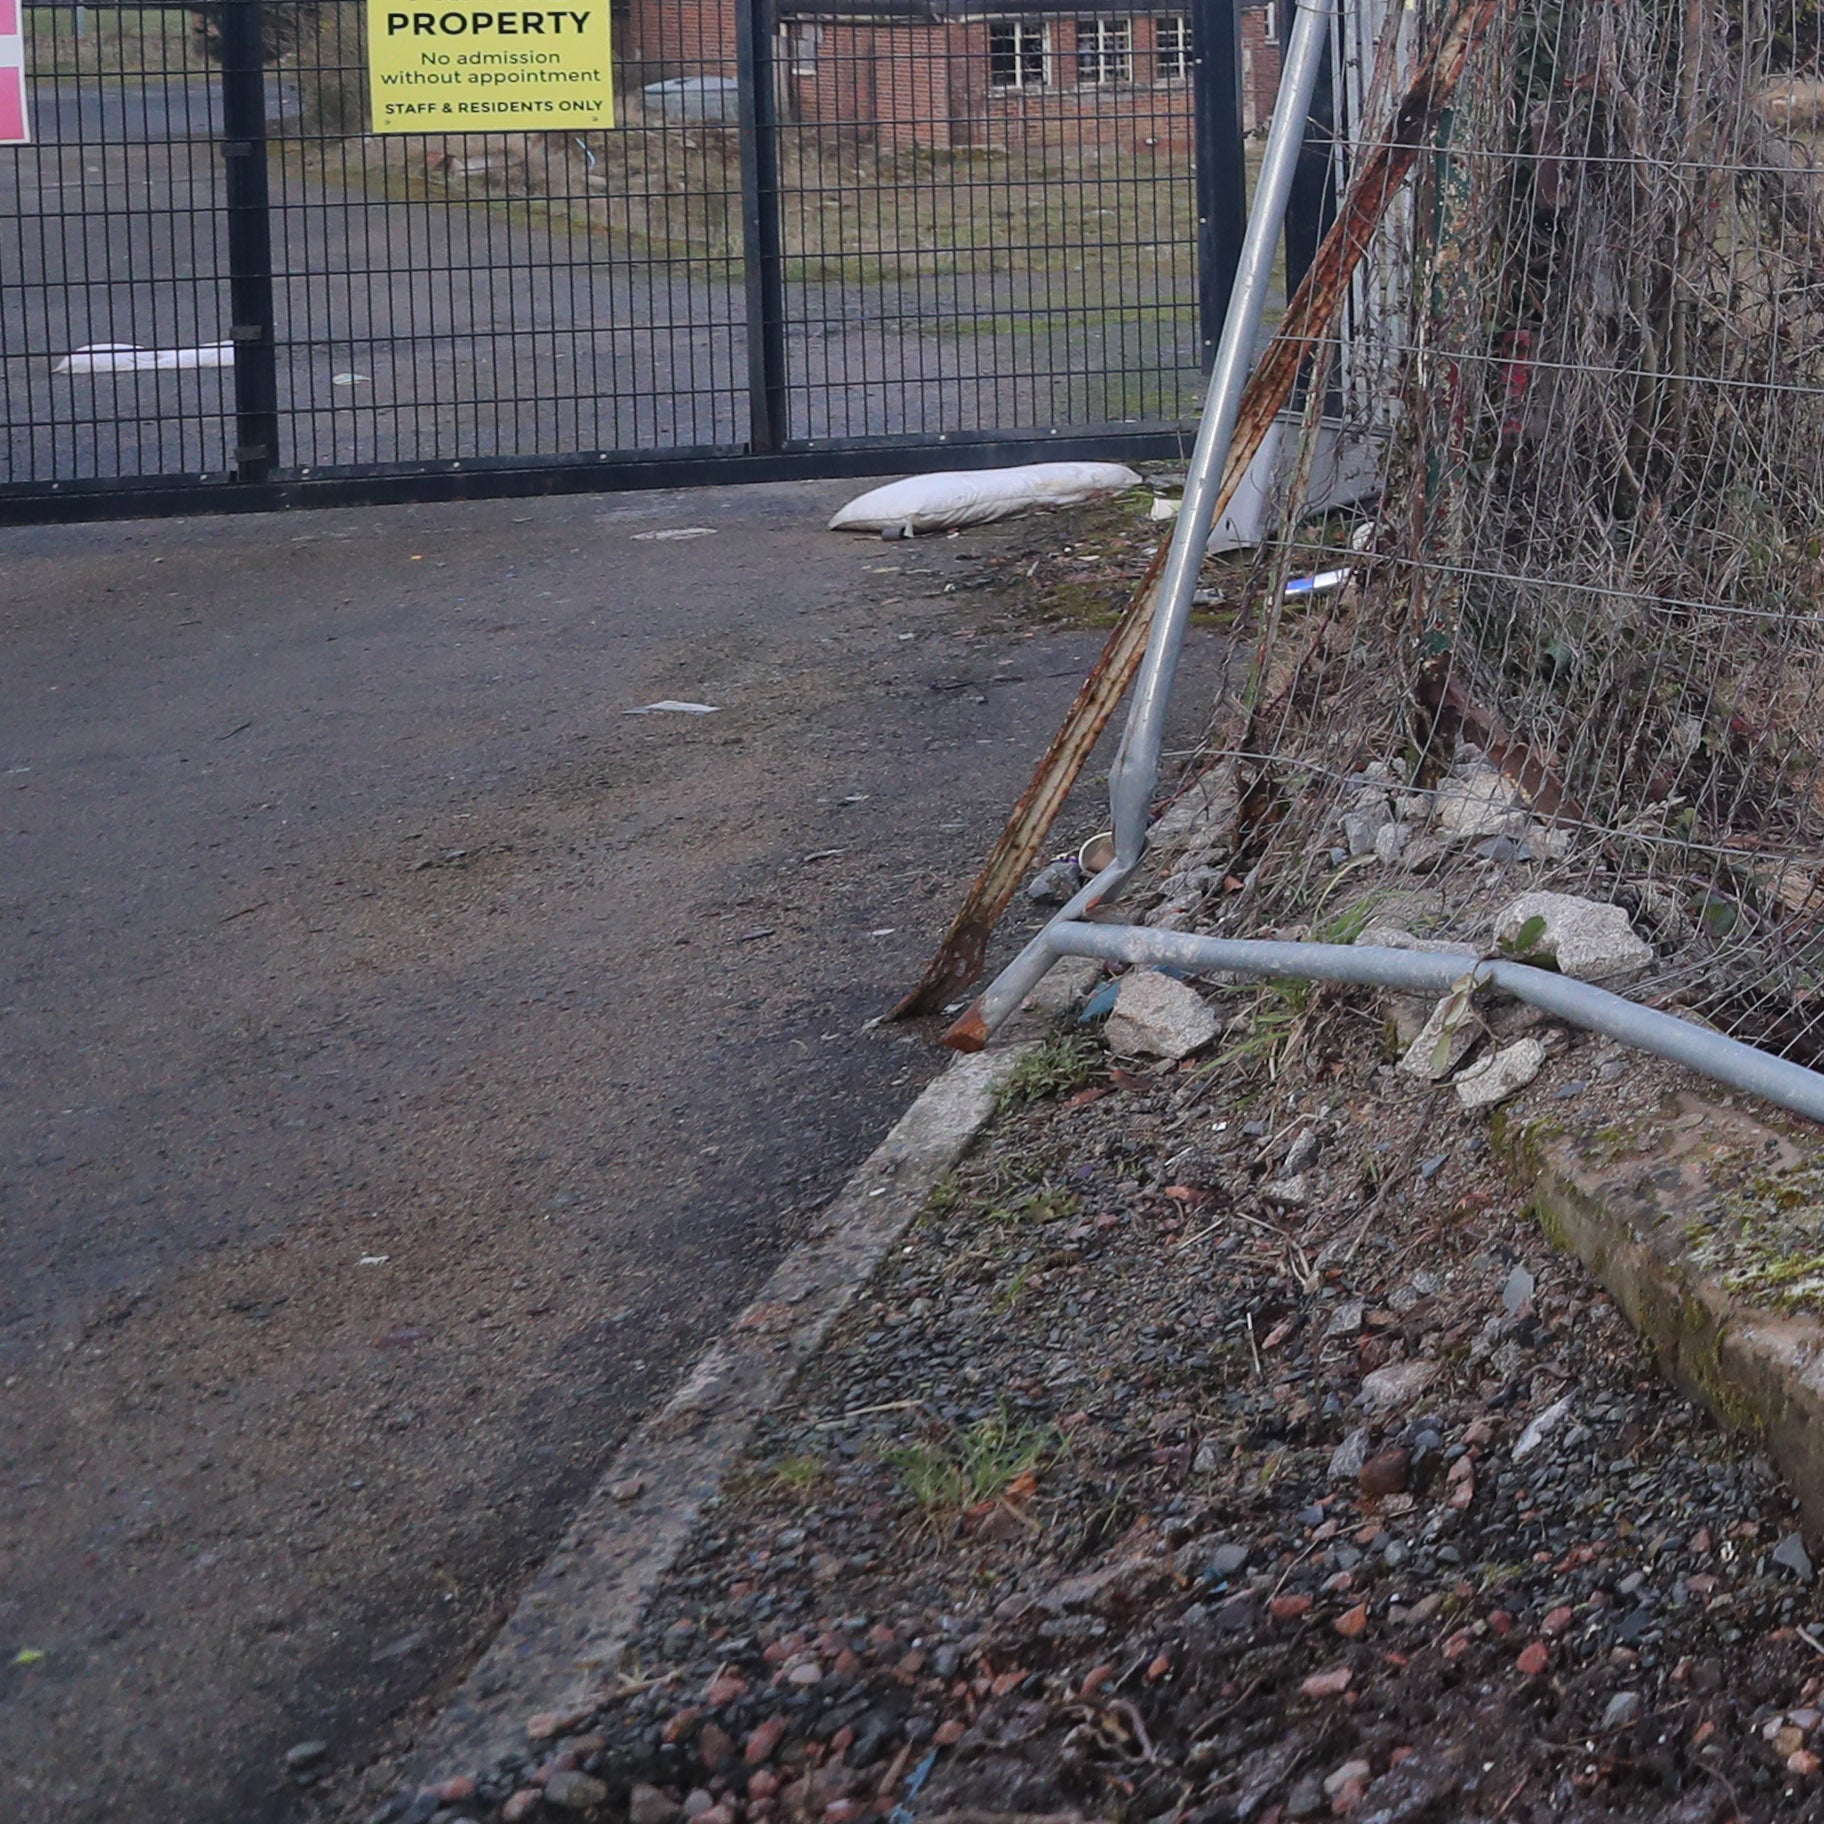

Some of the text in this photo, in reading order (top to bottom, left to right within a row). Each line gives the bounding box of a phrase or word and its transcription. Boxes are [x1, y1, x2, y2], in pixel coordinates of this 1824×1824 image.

[387, 11, 591, 36] PROPERTY
[421, 49, 561, 66] No admission
[380, 68, 601, 87] without appointment
[385, 100, 603, 115] STAFF & RESIDENTS ONLY
